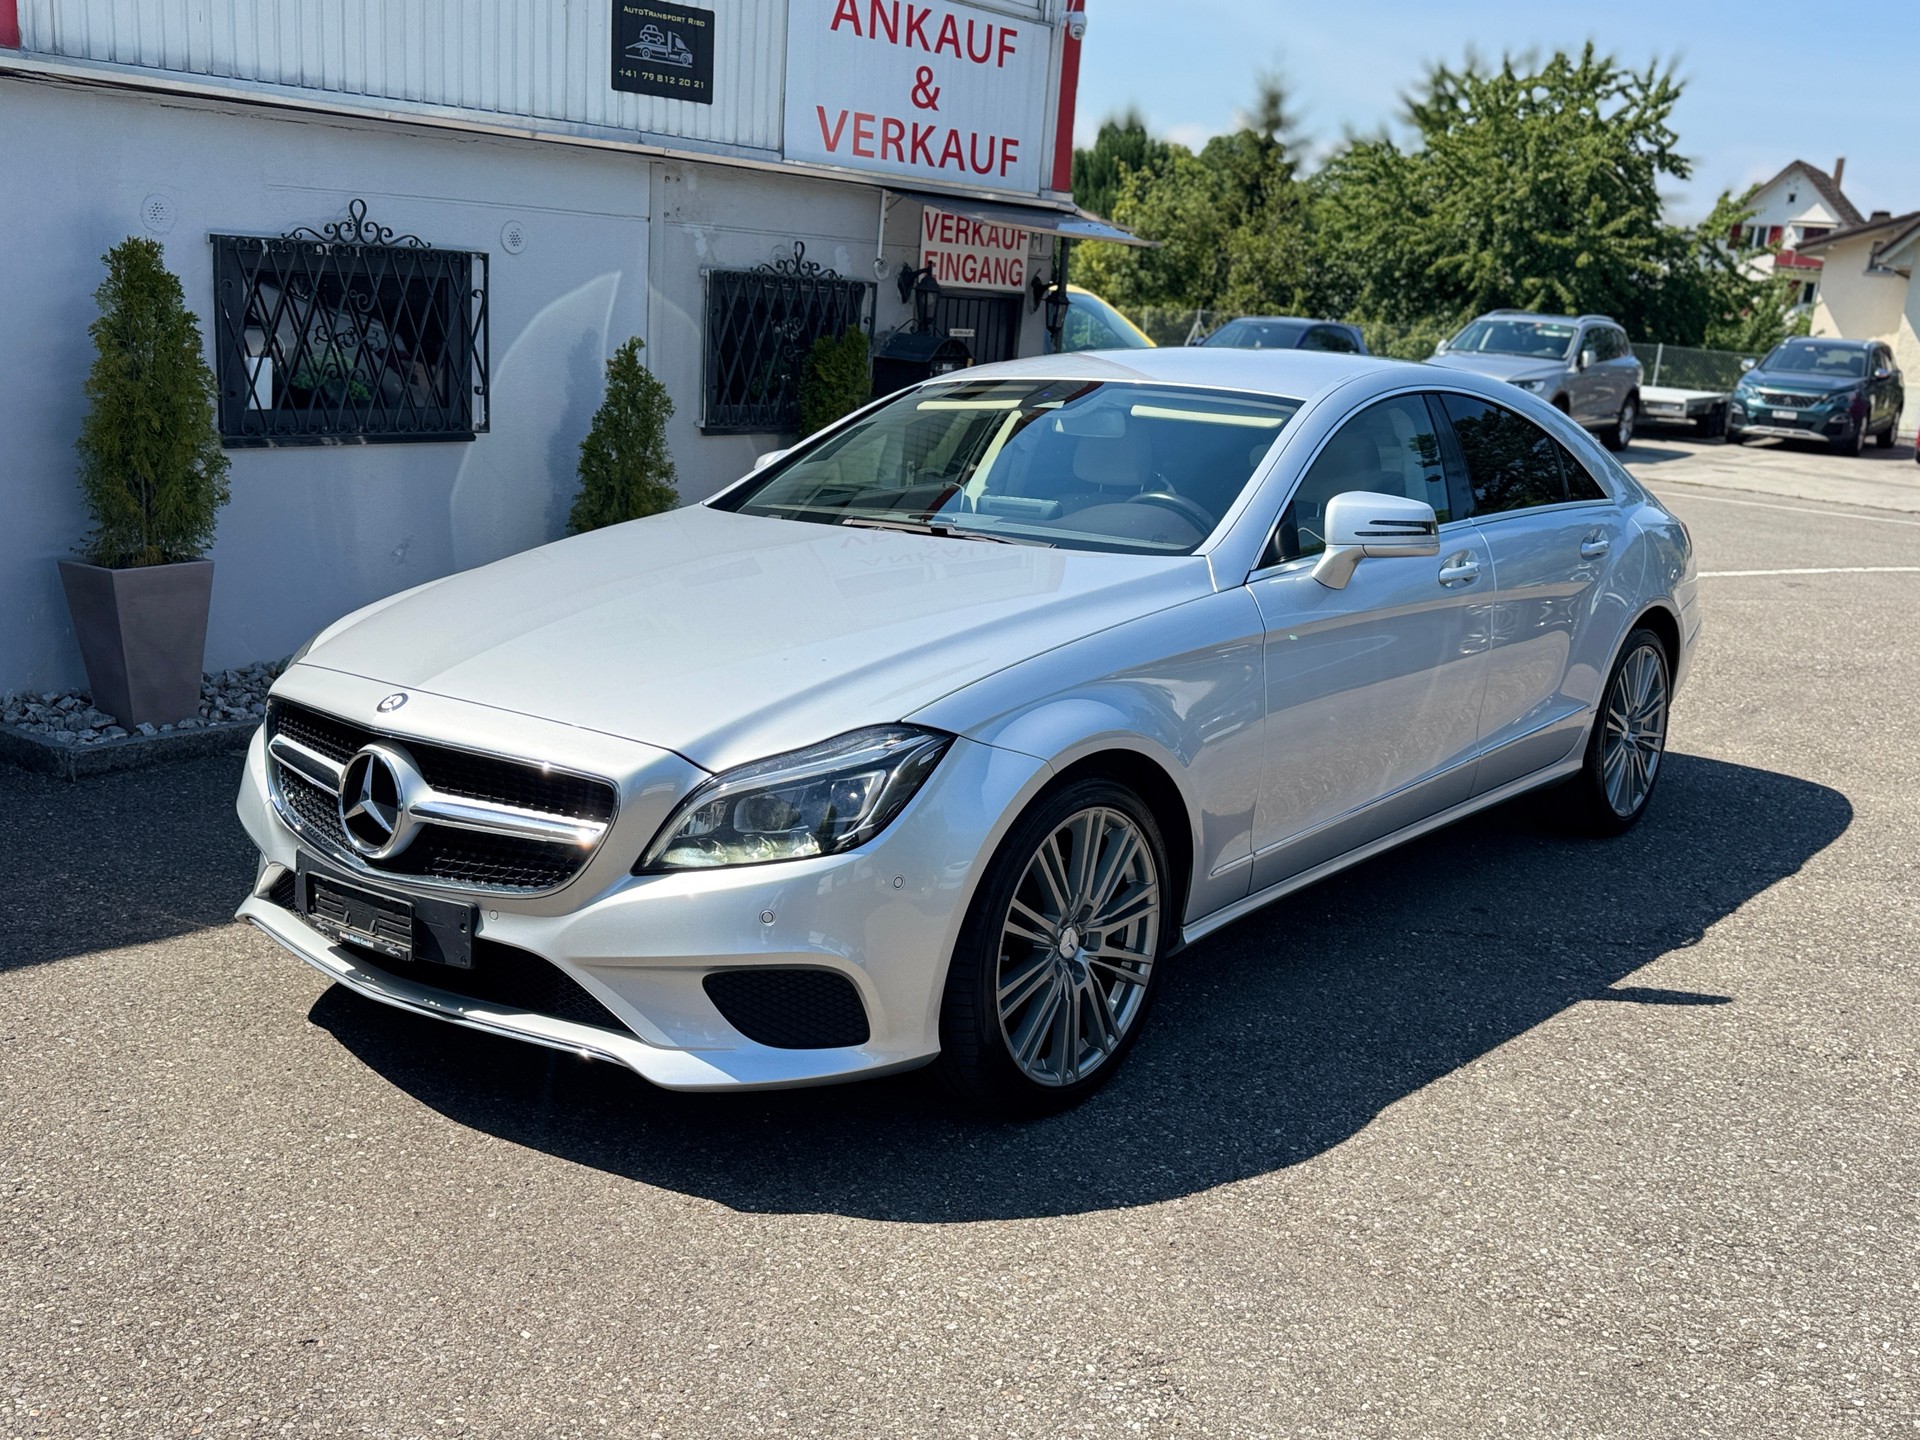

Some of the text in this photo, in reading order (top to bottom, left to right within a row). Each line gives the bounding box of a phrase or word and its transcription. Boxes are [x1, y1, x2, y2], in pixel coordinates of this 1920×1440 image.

[830, 0, 1018, 68] ANKAUF
[619, 68, 704, 89] +41 79 812 20 21
[911, 65, 940, 111] &
[816, 104, 1019, 177] VERKAUF
[925, 211, 1028, 250] VERKAUF
[924, 250, 1024, 287] EINGANG
